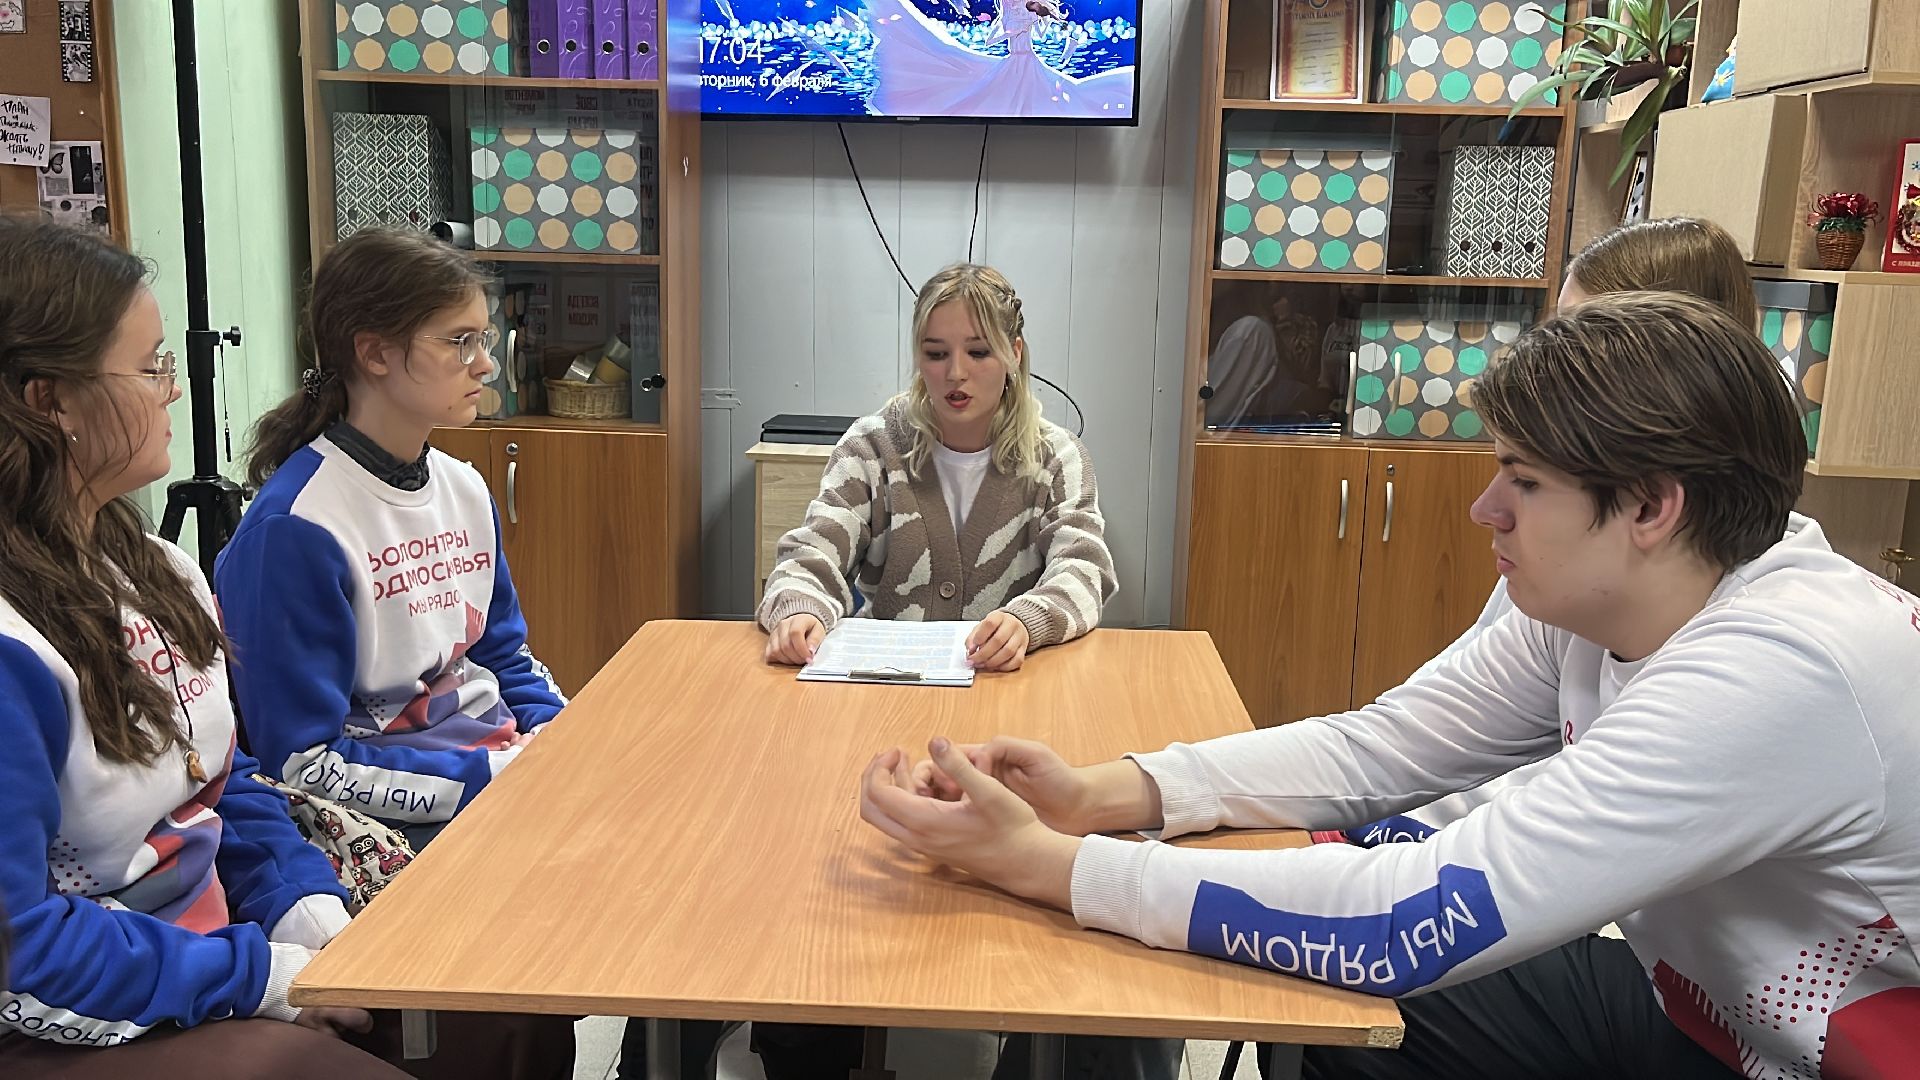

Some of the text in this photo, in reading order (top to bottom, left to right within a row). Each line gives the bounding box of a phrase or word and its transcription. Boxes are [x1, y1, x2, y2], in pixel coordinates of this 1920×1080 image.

[699, 36, 765, 64] 17:04
[760, 73, 769, 87] 6
[772, 72, 832, 91] февраля
[428, 589, 460, 612] РЯДО
[301, 761, 436, 814] МЫ РЯДО
[1221, 891, 1479, 986] МЫ РЯДОМ
